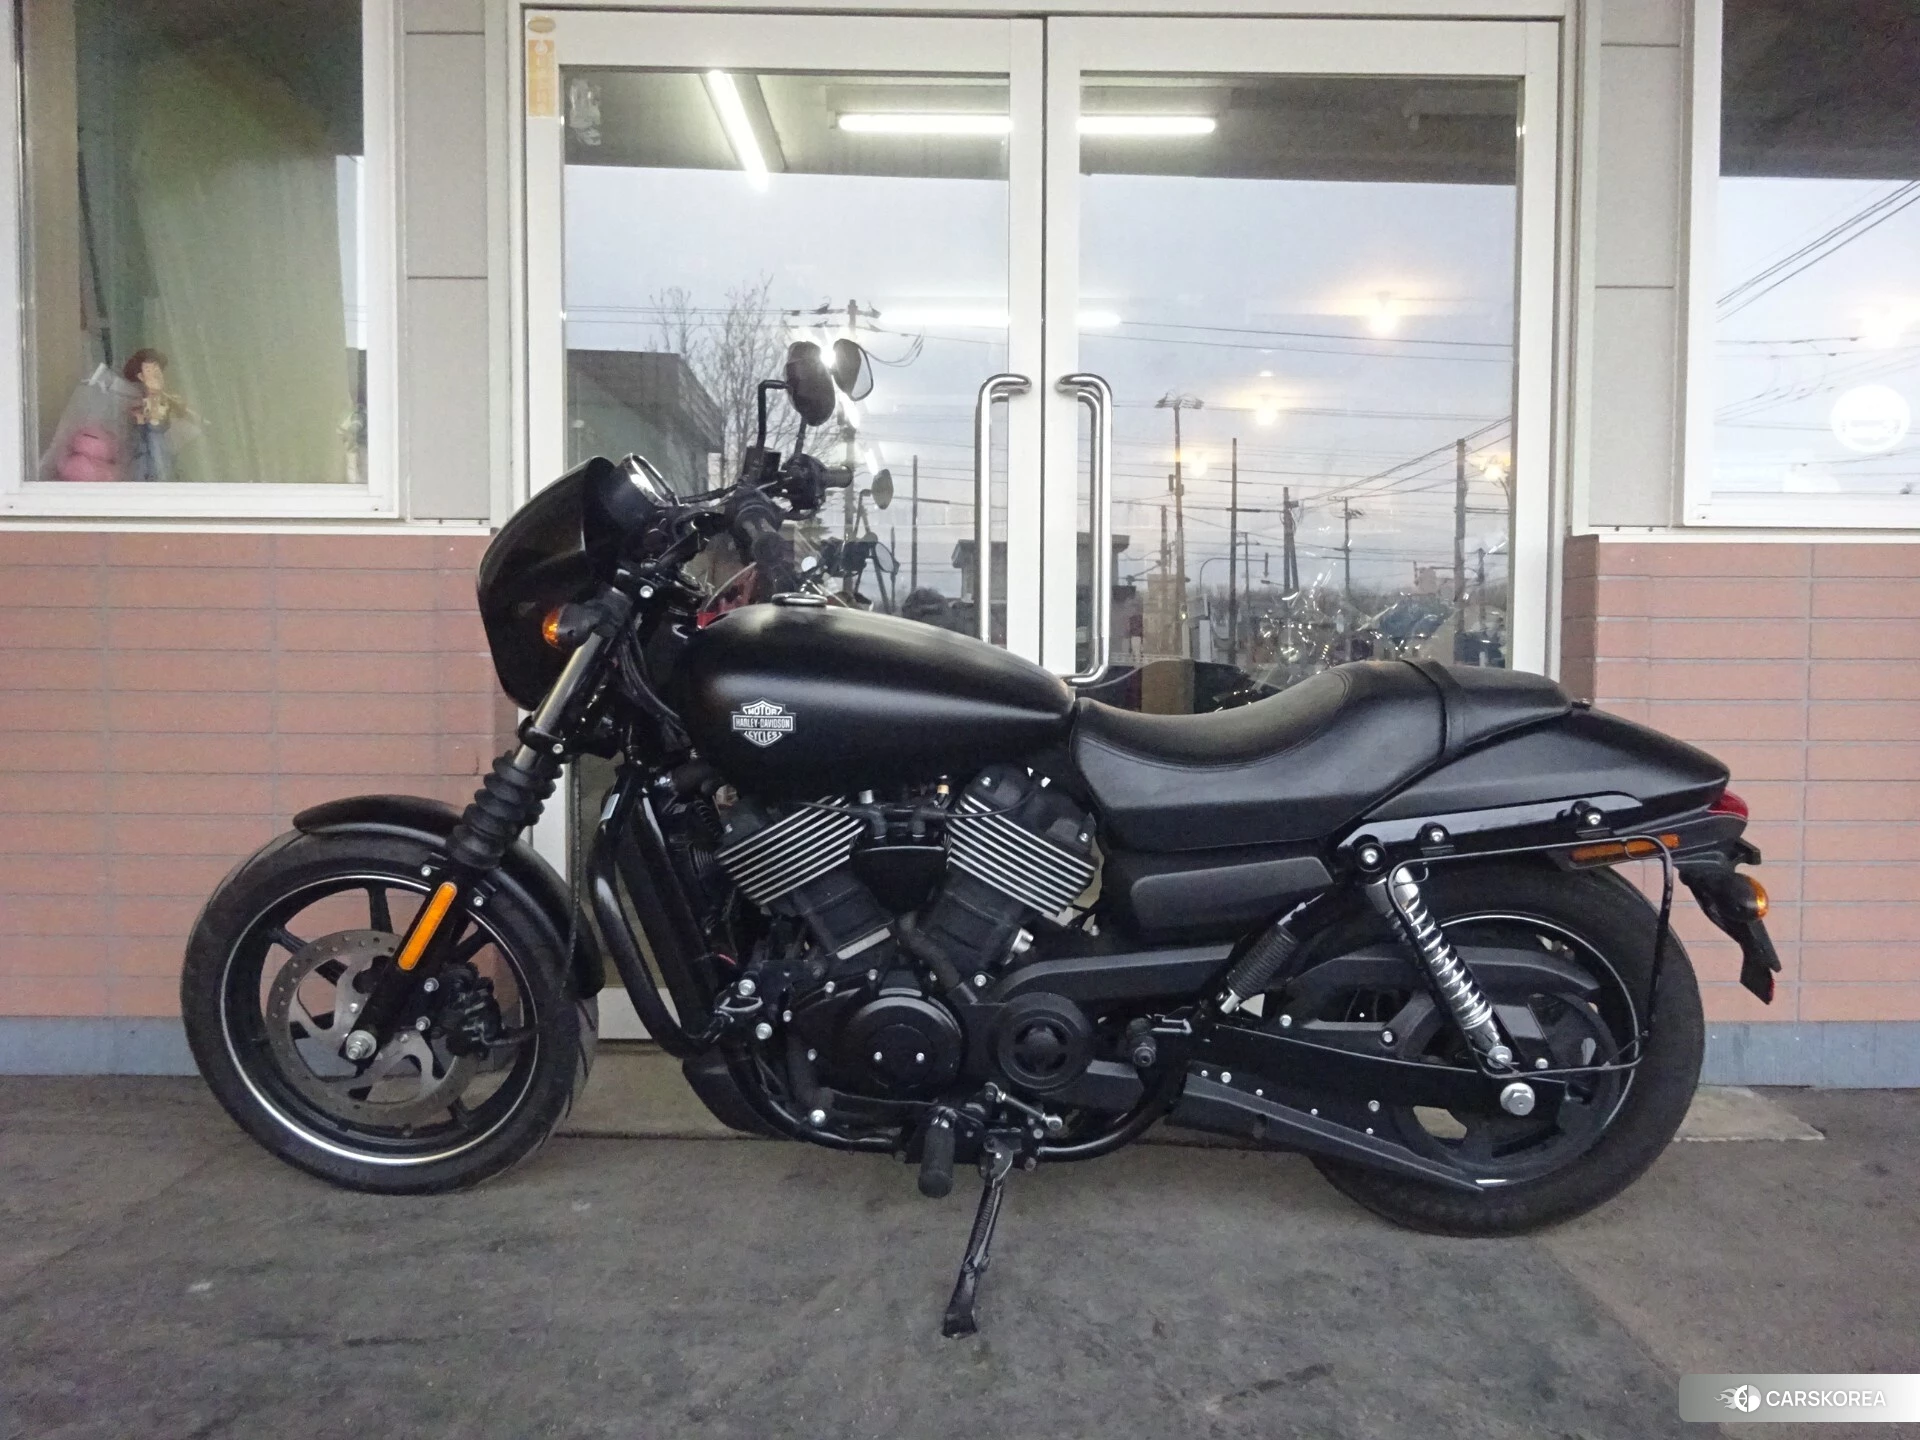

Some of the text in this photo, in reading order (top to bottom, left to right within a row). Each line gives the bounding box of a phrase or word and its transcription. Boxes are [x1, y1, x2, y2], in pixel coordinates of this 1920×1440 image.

[747, 704, 777, 715] MOTOR
[735, 718, 790, 728] HARLEY-DAVIDSON
[748, 731, 778, 742] CYCLES
